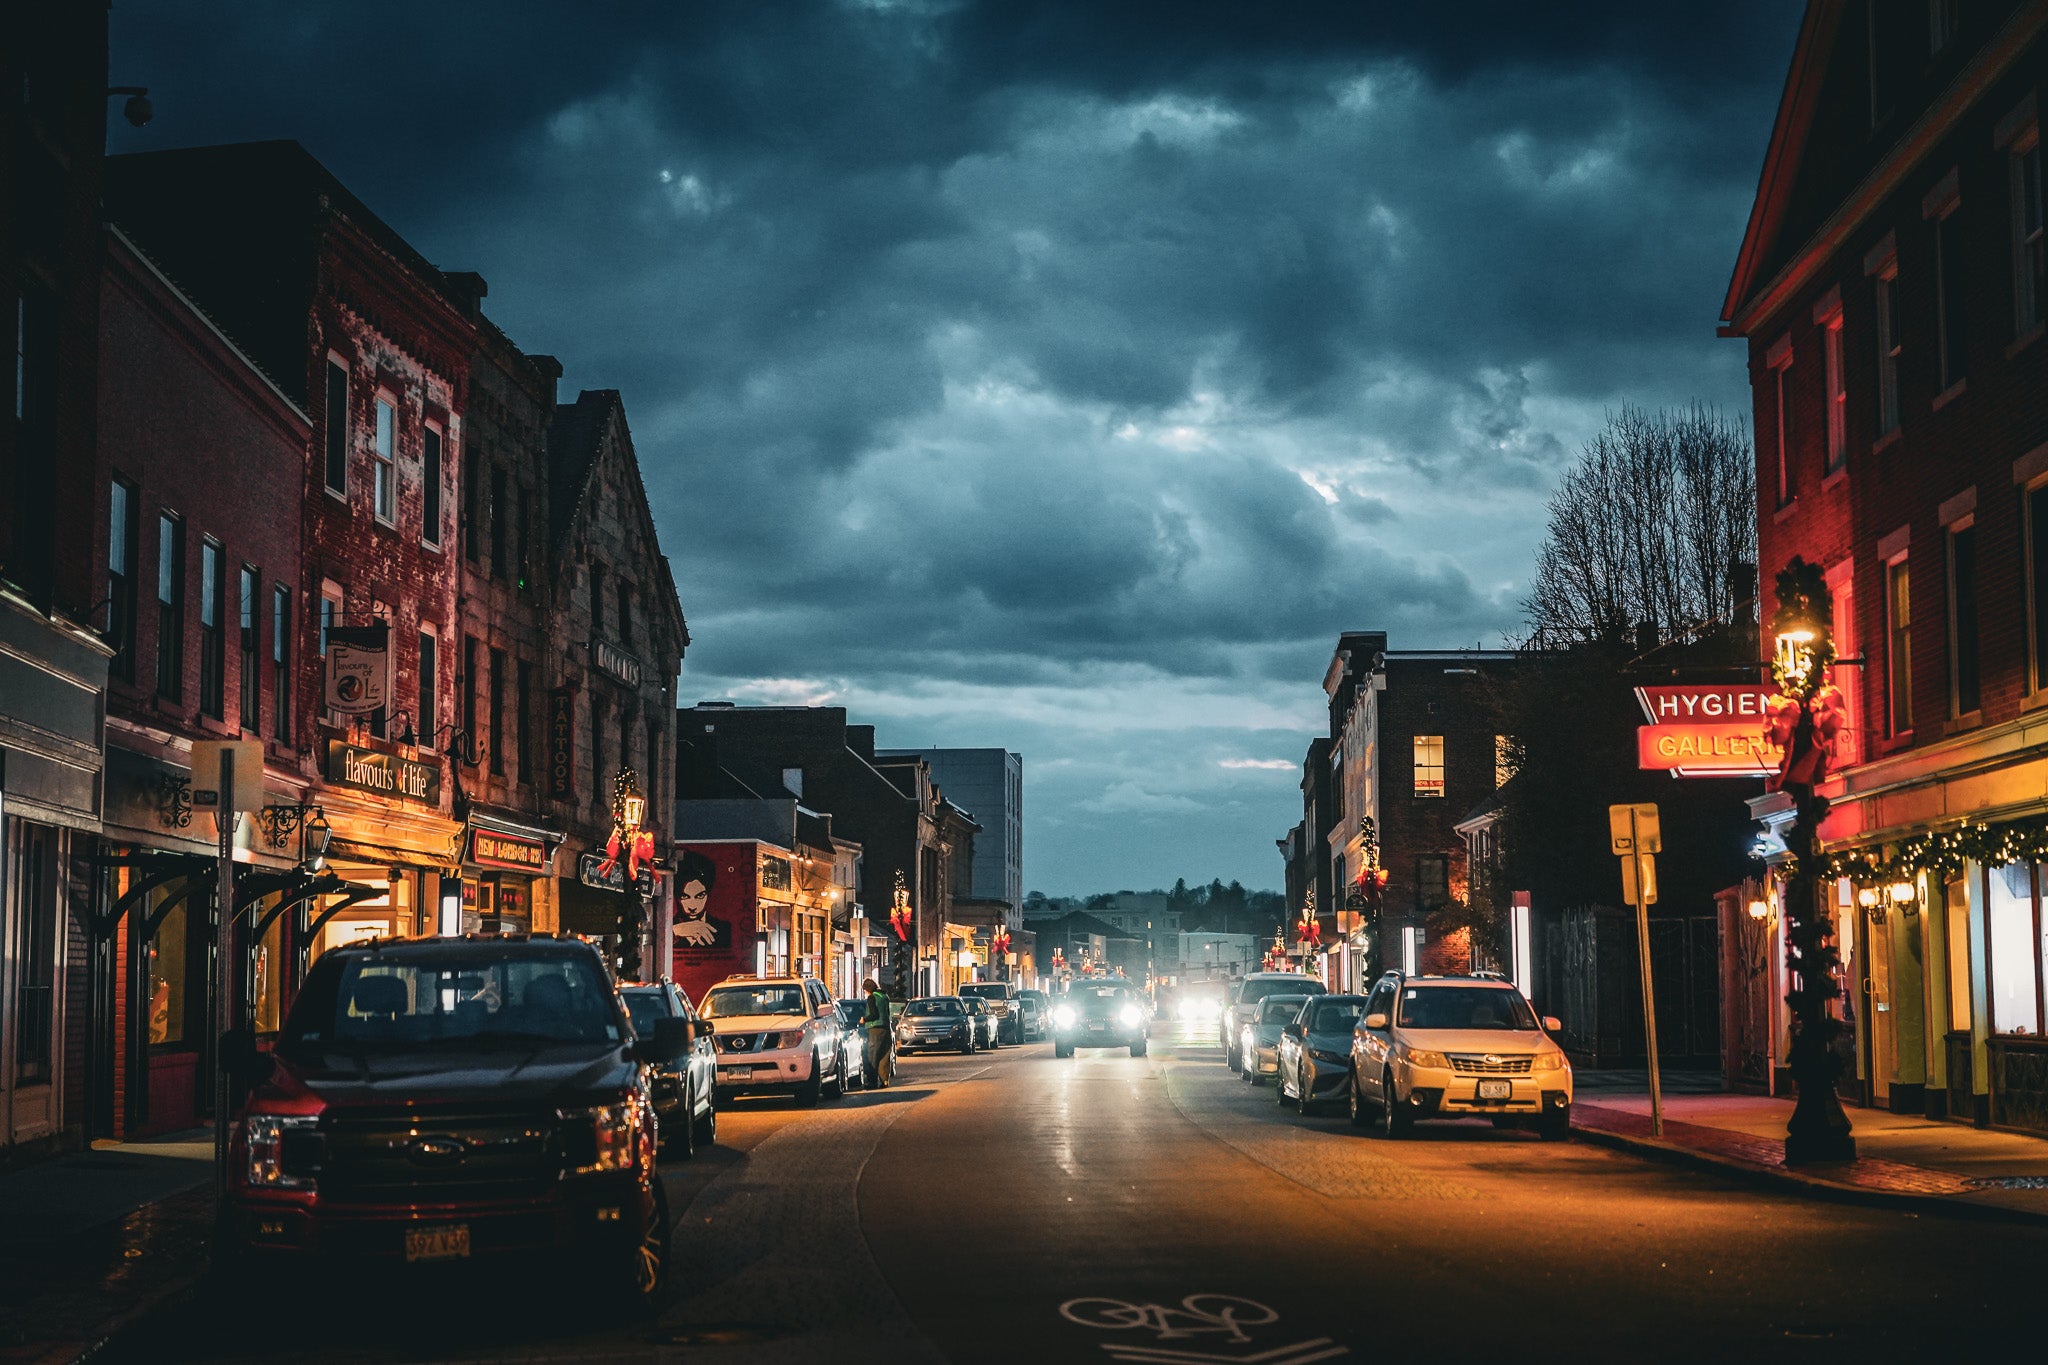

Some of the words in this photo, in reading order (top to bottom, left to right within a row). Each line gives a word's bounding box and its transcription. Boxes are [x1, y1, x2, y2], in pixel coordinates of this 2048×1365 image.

[333, 648, 368, 680] Flavours
[362, 665, 375, 677] of
[365, 677, 380, 699] Life
[1658, 693, 1771, 717] HYGIEN
[554, 696, 568, 792] TATTOOS
[1658, 735, 1785, 756] GALLERI
[345, 748, 393, 791] flavours
[408, 764, 427, 798] life
[478, 837, 495, 857] NEW
[497, 841, 528, 862] LONDON
[530, 847, 543, 864] INK
